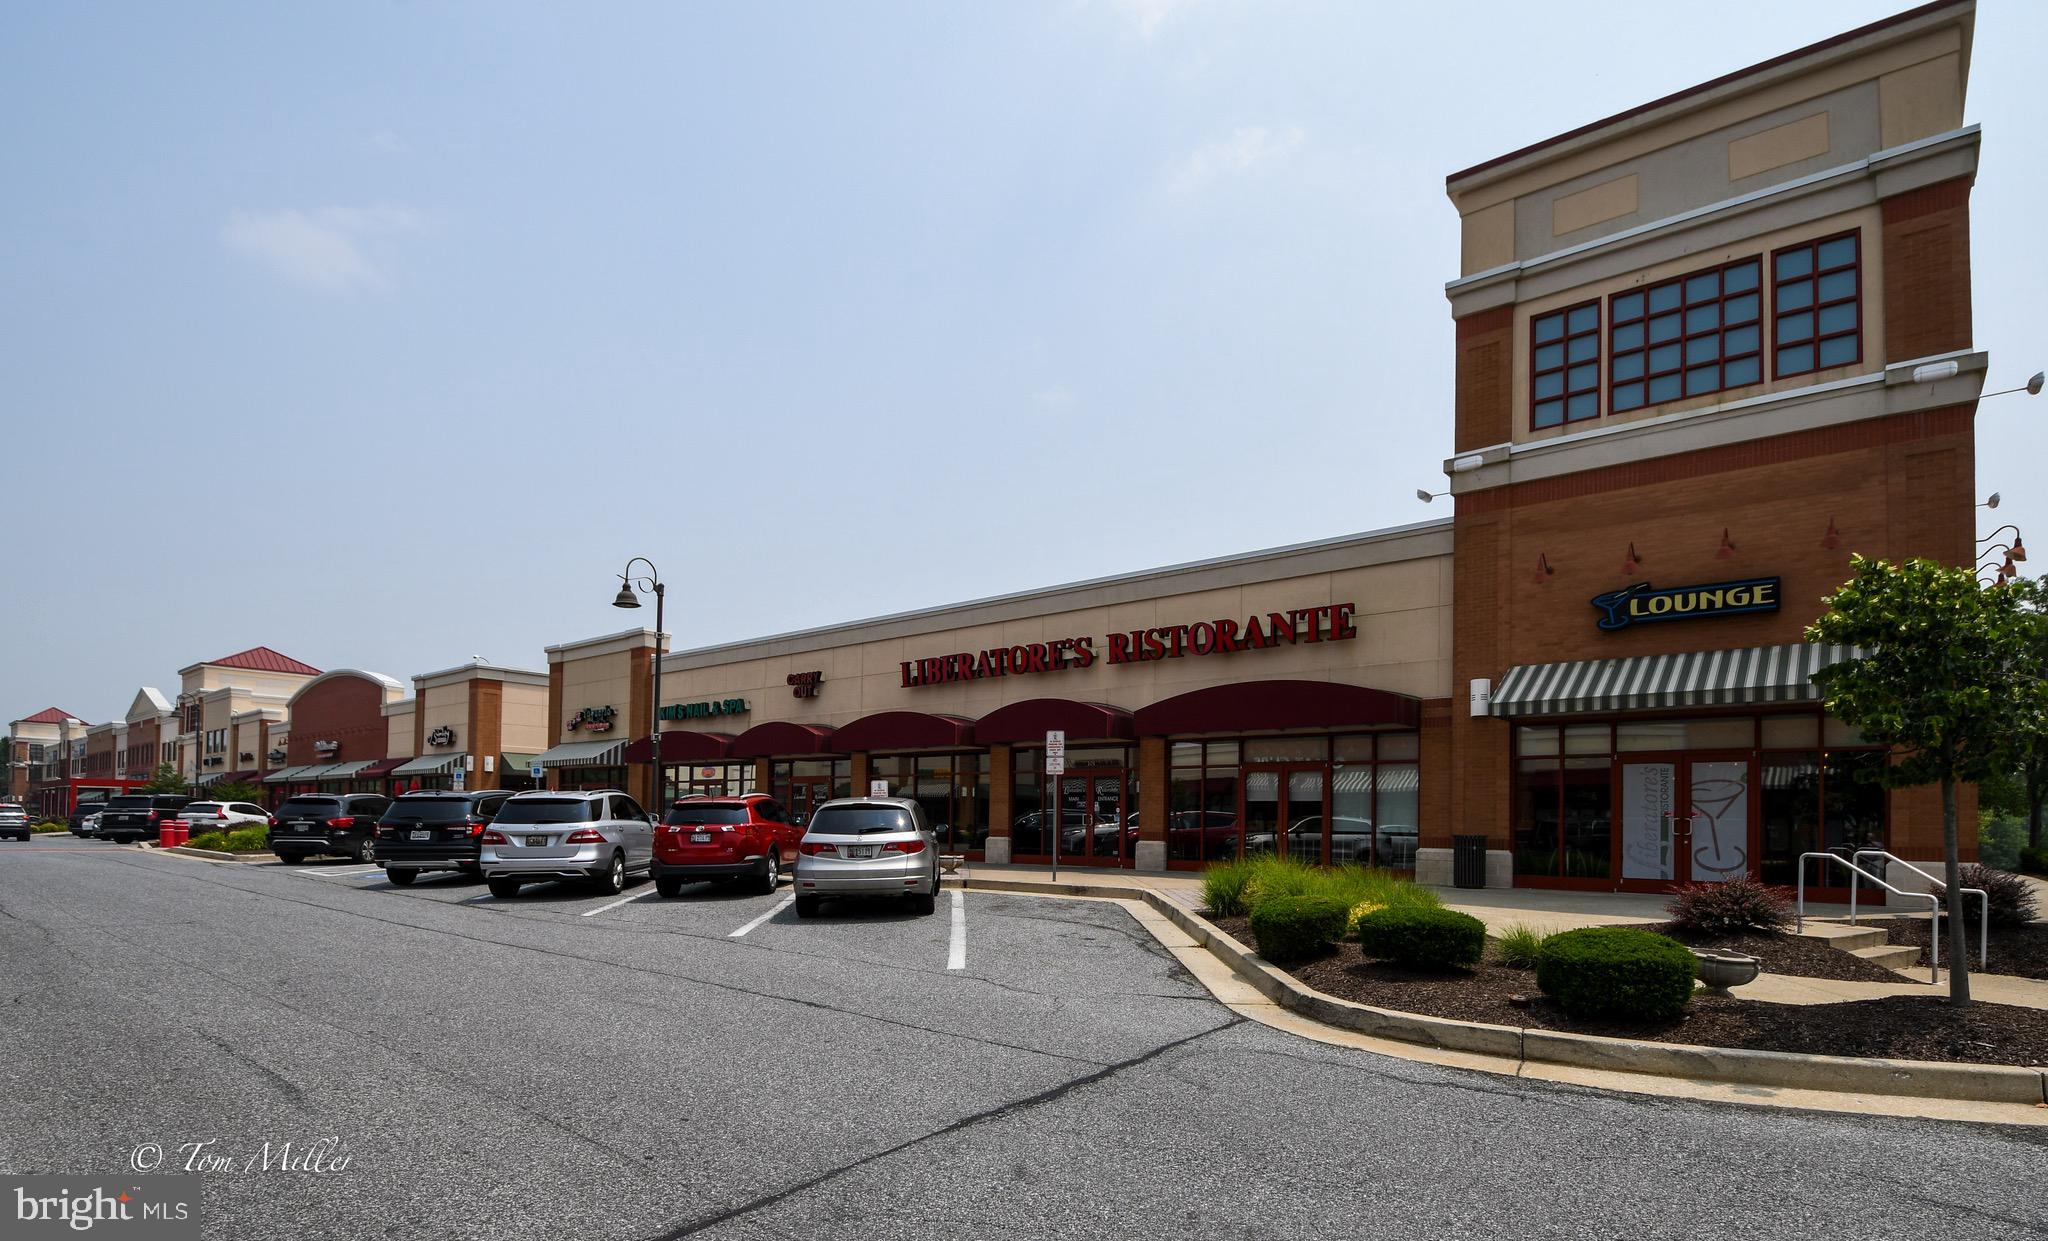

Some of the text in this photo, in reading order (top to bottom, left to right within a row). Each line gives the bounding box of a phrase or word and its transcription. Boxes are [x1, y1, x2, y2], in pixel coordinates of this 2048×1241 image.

[1630, 584, 1774, 616] LOUNGE
[901, 603, 1356, 688] LIBERATORE'S RISTORANTE
[787, 671, 822, 686] CARRY
[793, 686, 814, 698] OUT
[686, 702, 708, 715] NAIL
[712, 701, 721, 715] &
[723, 698, 745, 715] SPA
